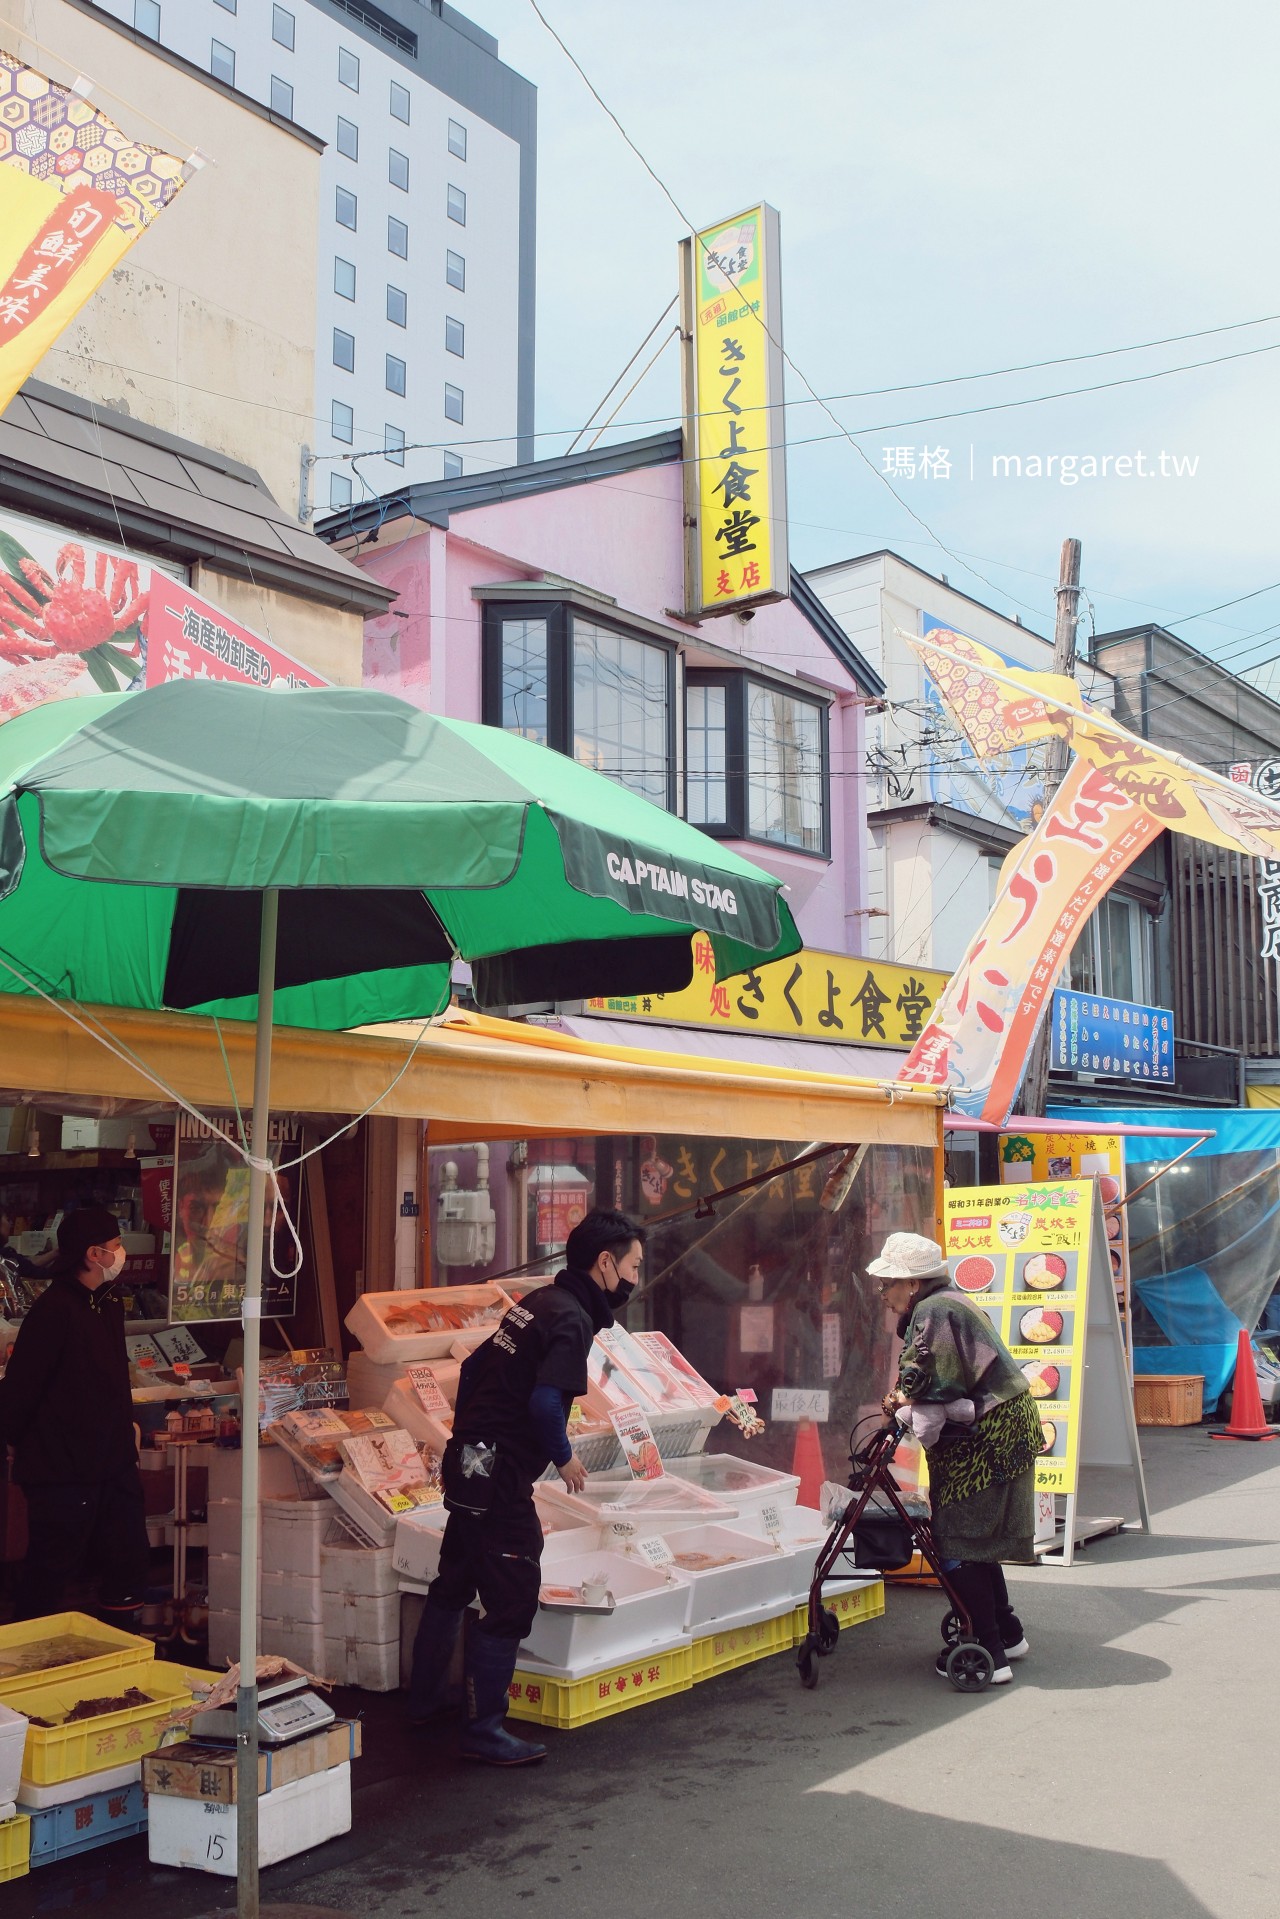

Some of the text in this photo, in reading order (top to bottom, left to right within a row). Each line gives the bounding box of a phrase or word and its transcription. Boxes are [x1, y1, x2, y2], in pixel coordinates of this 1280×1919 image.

[0, 202, 102, 325] 旬鮮美味
[709, 337, 762, 561] きくよ食堂
[714, 562, 761, 597] 支店
[606, 852, 738, 916] CAPTAIN STAG
[695, 941, 731, 1019] 味処
[948, 1197, 1011, 1209] 昭和31年創業の
[1015, 1189, 1080, 1207] 名物食堂
[1033, 1216, 1078, 1231] 炭炊き
[947, 1235, 993, 1250] 炭火焼
[775, 1391, 825, 1413] 最後尾
[599, 1665, 661, 1699] 活魚専用
[207, 1834, 228, 1861] 15
